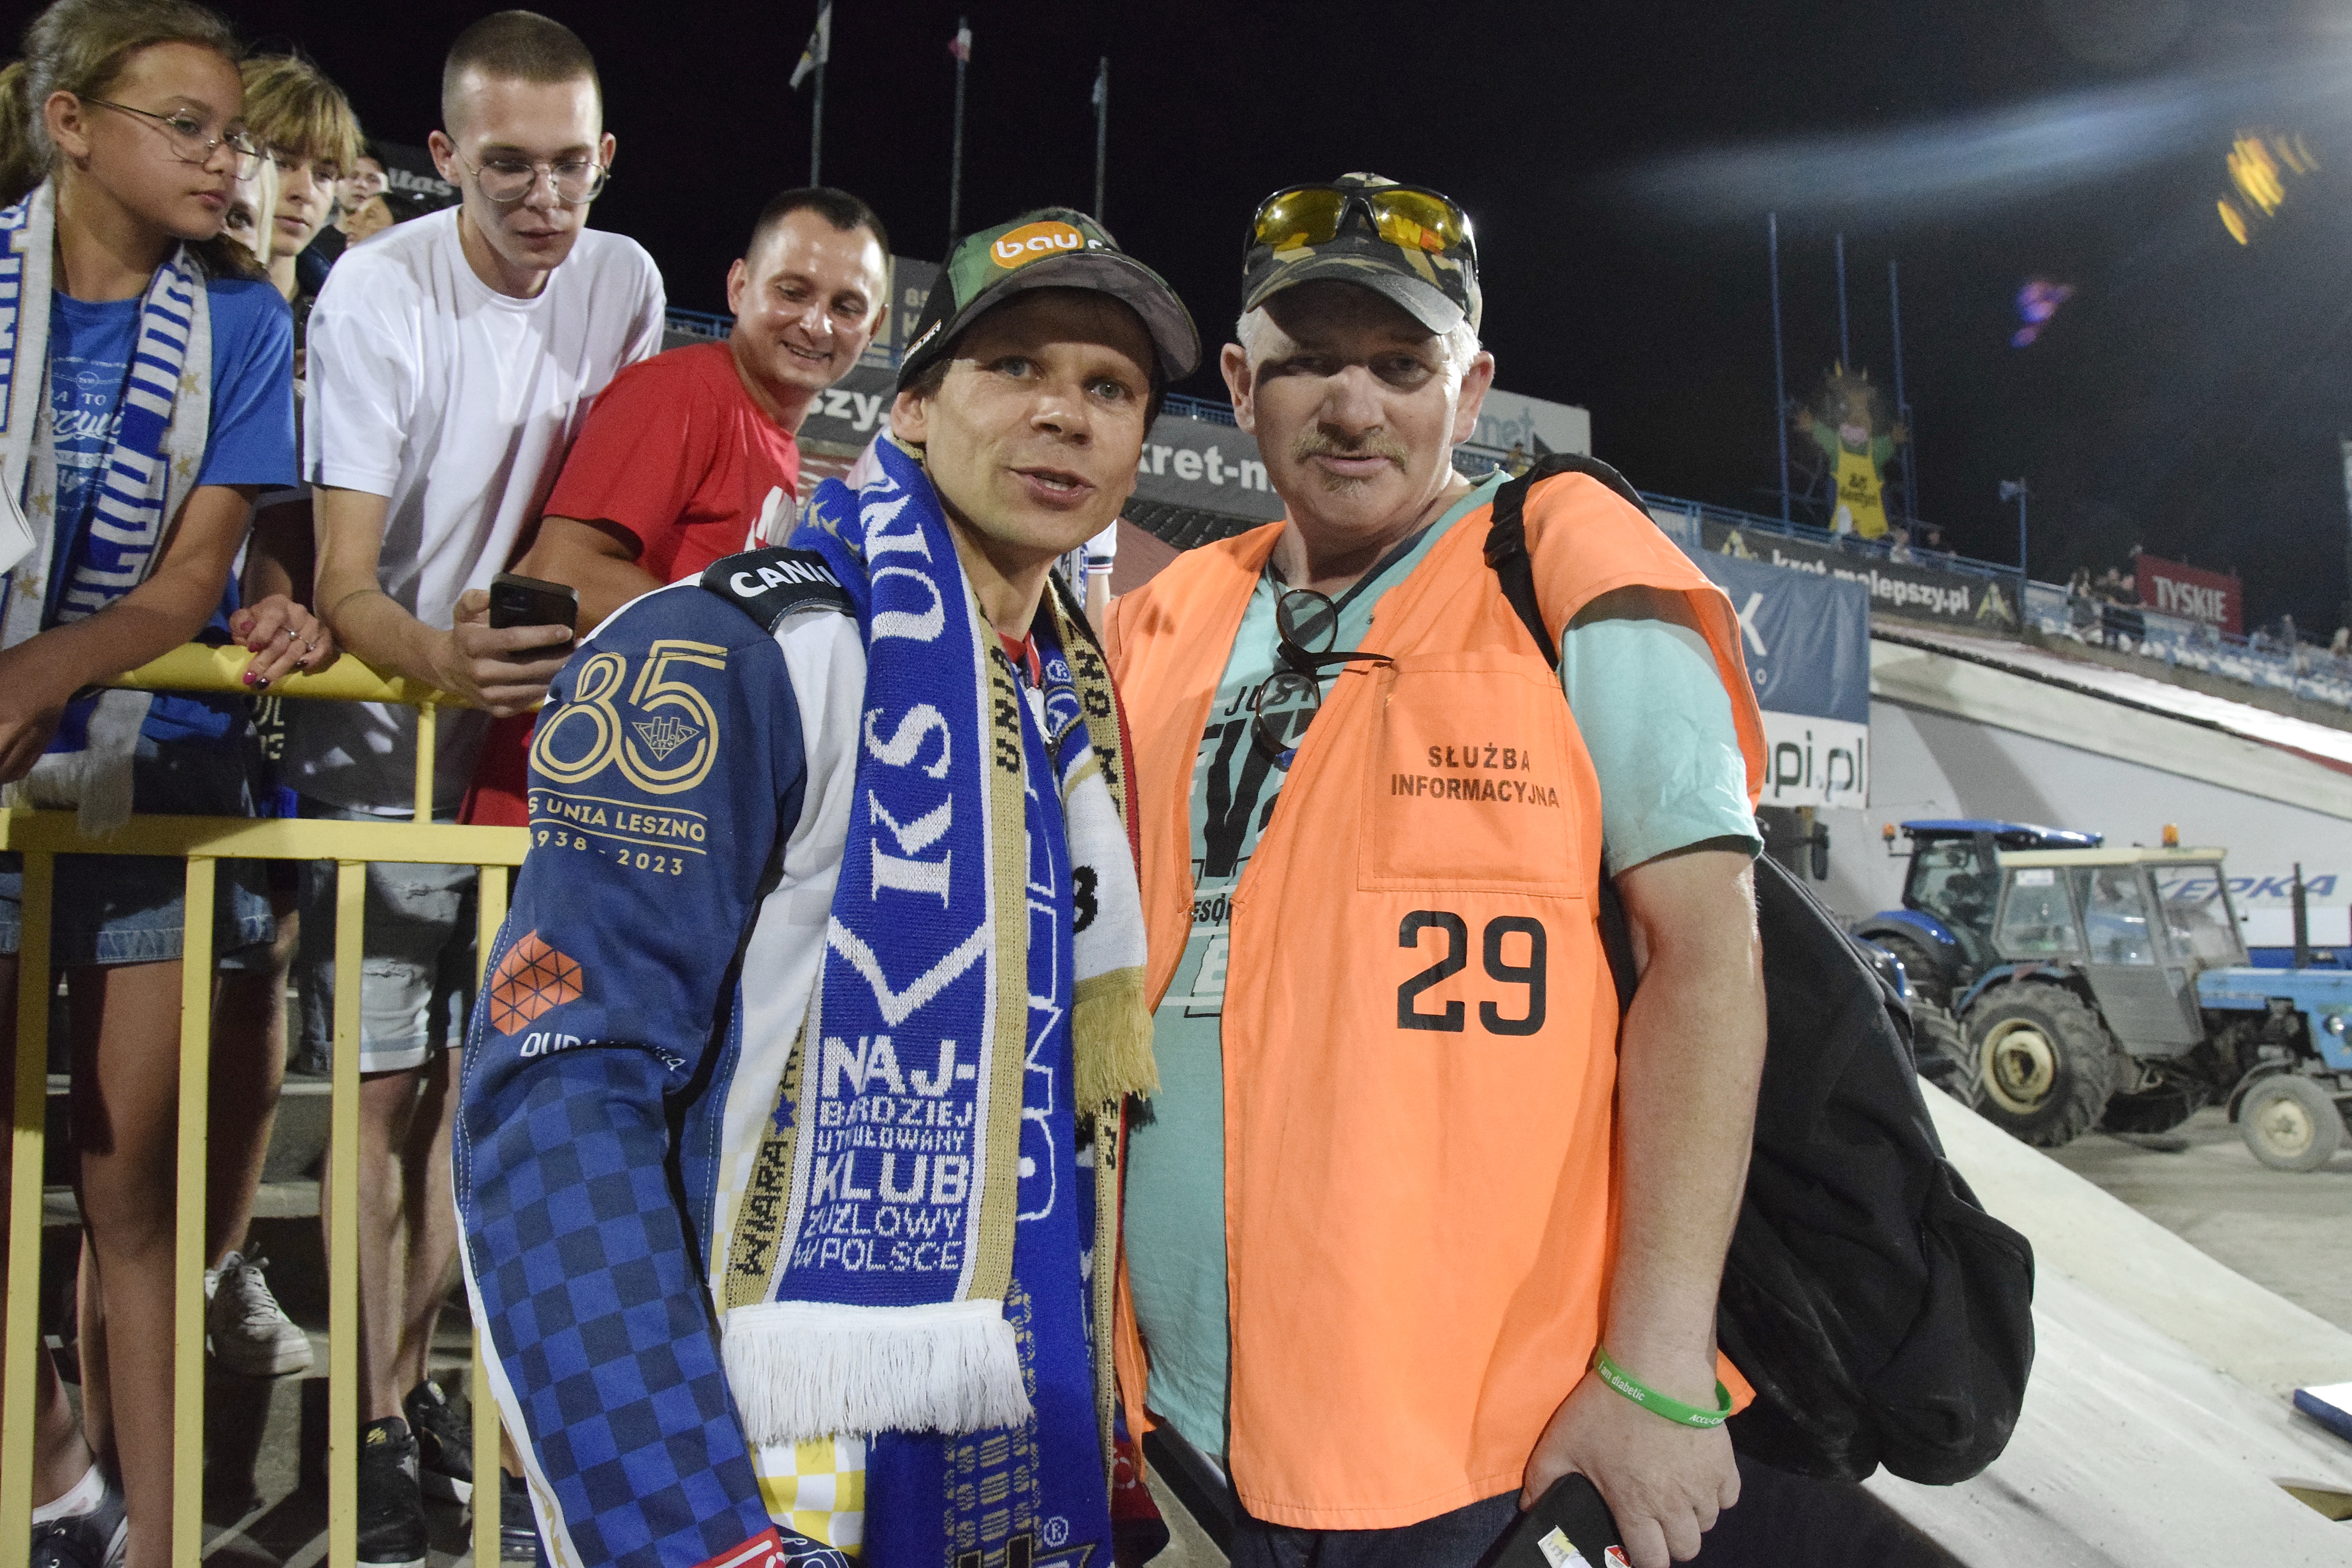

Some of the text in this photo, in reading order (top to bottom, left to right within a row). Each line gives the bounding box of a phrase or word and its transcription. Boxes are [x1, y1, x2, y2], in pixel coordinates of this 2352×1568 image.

[2153, 575, 2228, 623] TYSKIE
[530, 639, 728, 795] 85
[1428, 741, 1530, 773] SŁUŻBA
[1765, 730, 1863, 802] pi.pl
[864, 704, 953, 909] KS
[1391, 774, 1560, 808] INFORMACYJNA
[546, 797, 607, 826] UNIA
[616, 811, 706, 842] LESZNO
[617, 849, 683, 876] 2023
[1397, 909, 1547, 1036] 29
[822, 1035, 975, 1098] NAJ-
[811, 1150, 970, 1207] KLUB
[734, 1141, 788, 1276] WIARA
[820, 1238, 962, 1272] POLSCE
[1601, 1367, 1613, 1380] am
[1611, 1375, 1645, 1402] diabetic
